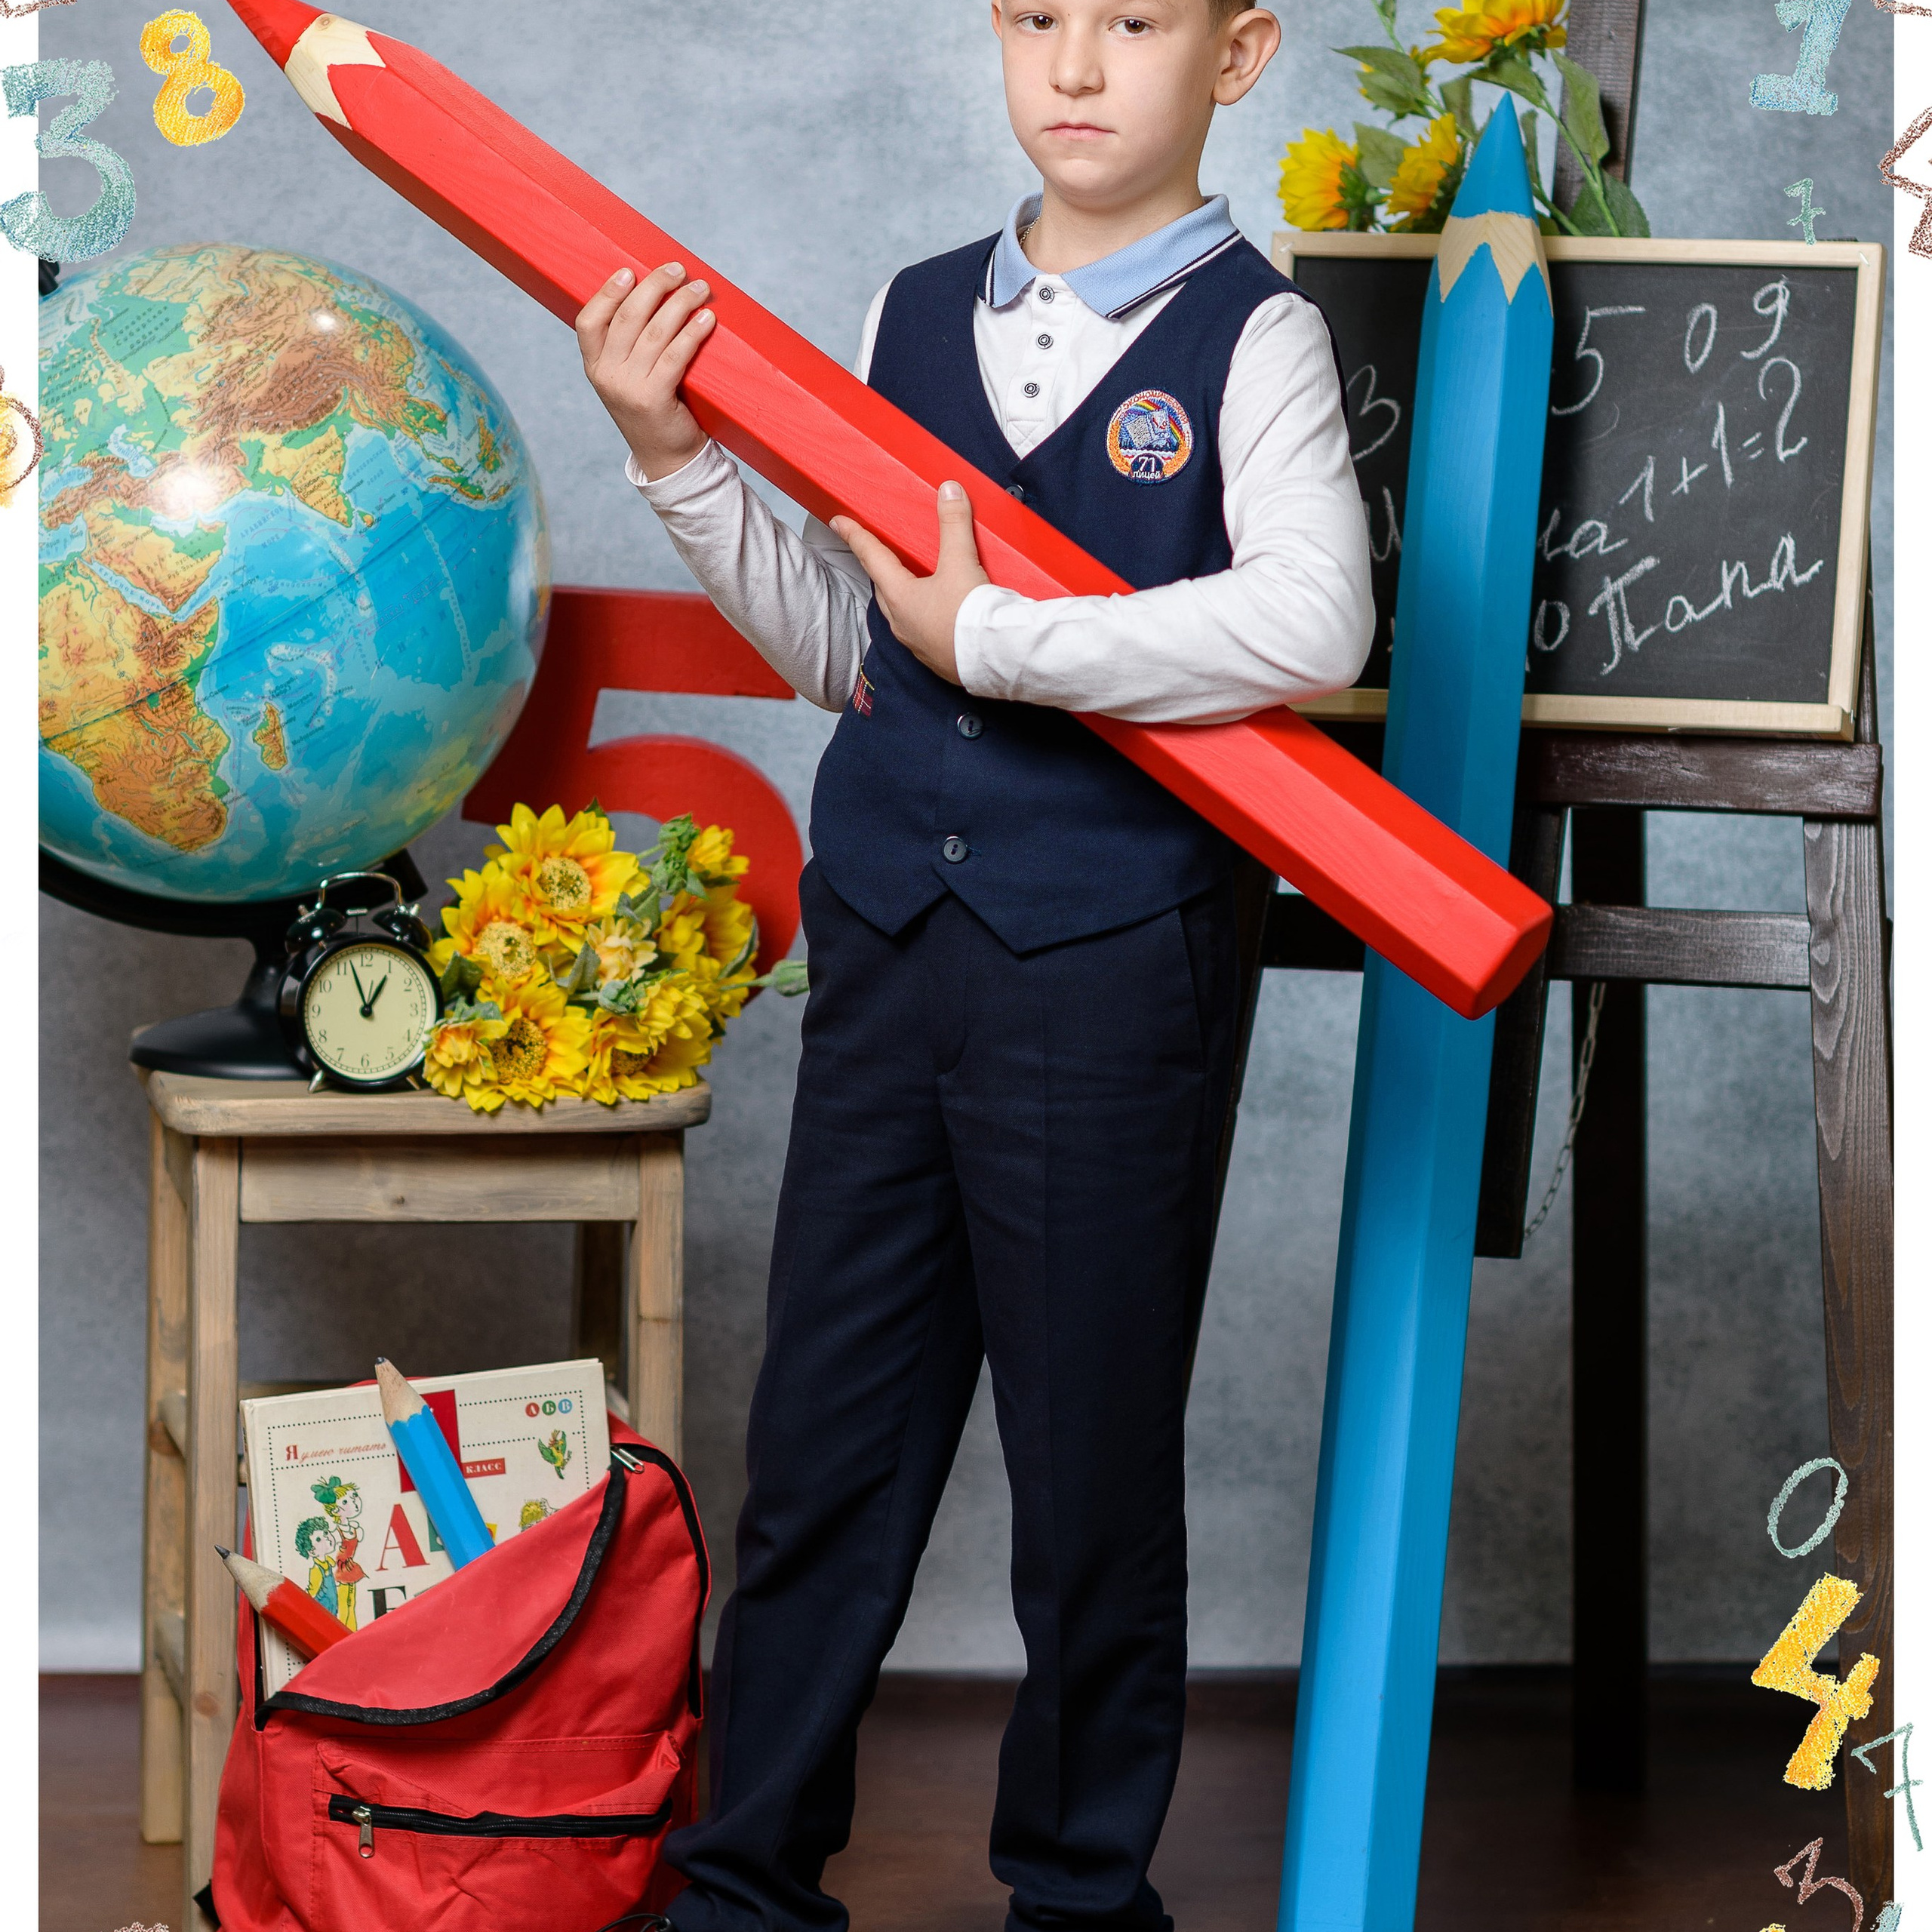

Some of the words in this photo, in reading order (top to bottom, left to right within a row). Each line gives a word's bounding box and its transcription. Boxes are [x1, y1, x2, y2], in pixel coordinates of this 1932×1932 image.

[1138, 456, 1155, 472] 71
[359, 952, 374, 968] 12
[386, 960, 392, 974] 1
[336, 961, 347, 976] 11
[318, 980, 332, 993] 10
[403, 978, 412, 992] 2
[312, 1004, 321, 1019] 9
[410, 1003, 419, 1017] 3
[318, 1029, 328, 1043] 8
[403, 1029, 411, 1042] 4
[336, 1048, 345, 1062] 7
[386, 1046, 395, 1061] 5
[361, 1054, 370, 1069] 6
[285, 1444, 300, 1460] Я
[466, 1462, 502, 1475] КЛАСС
